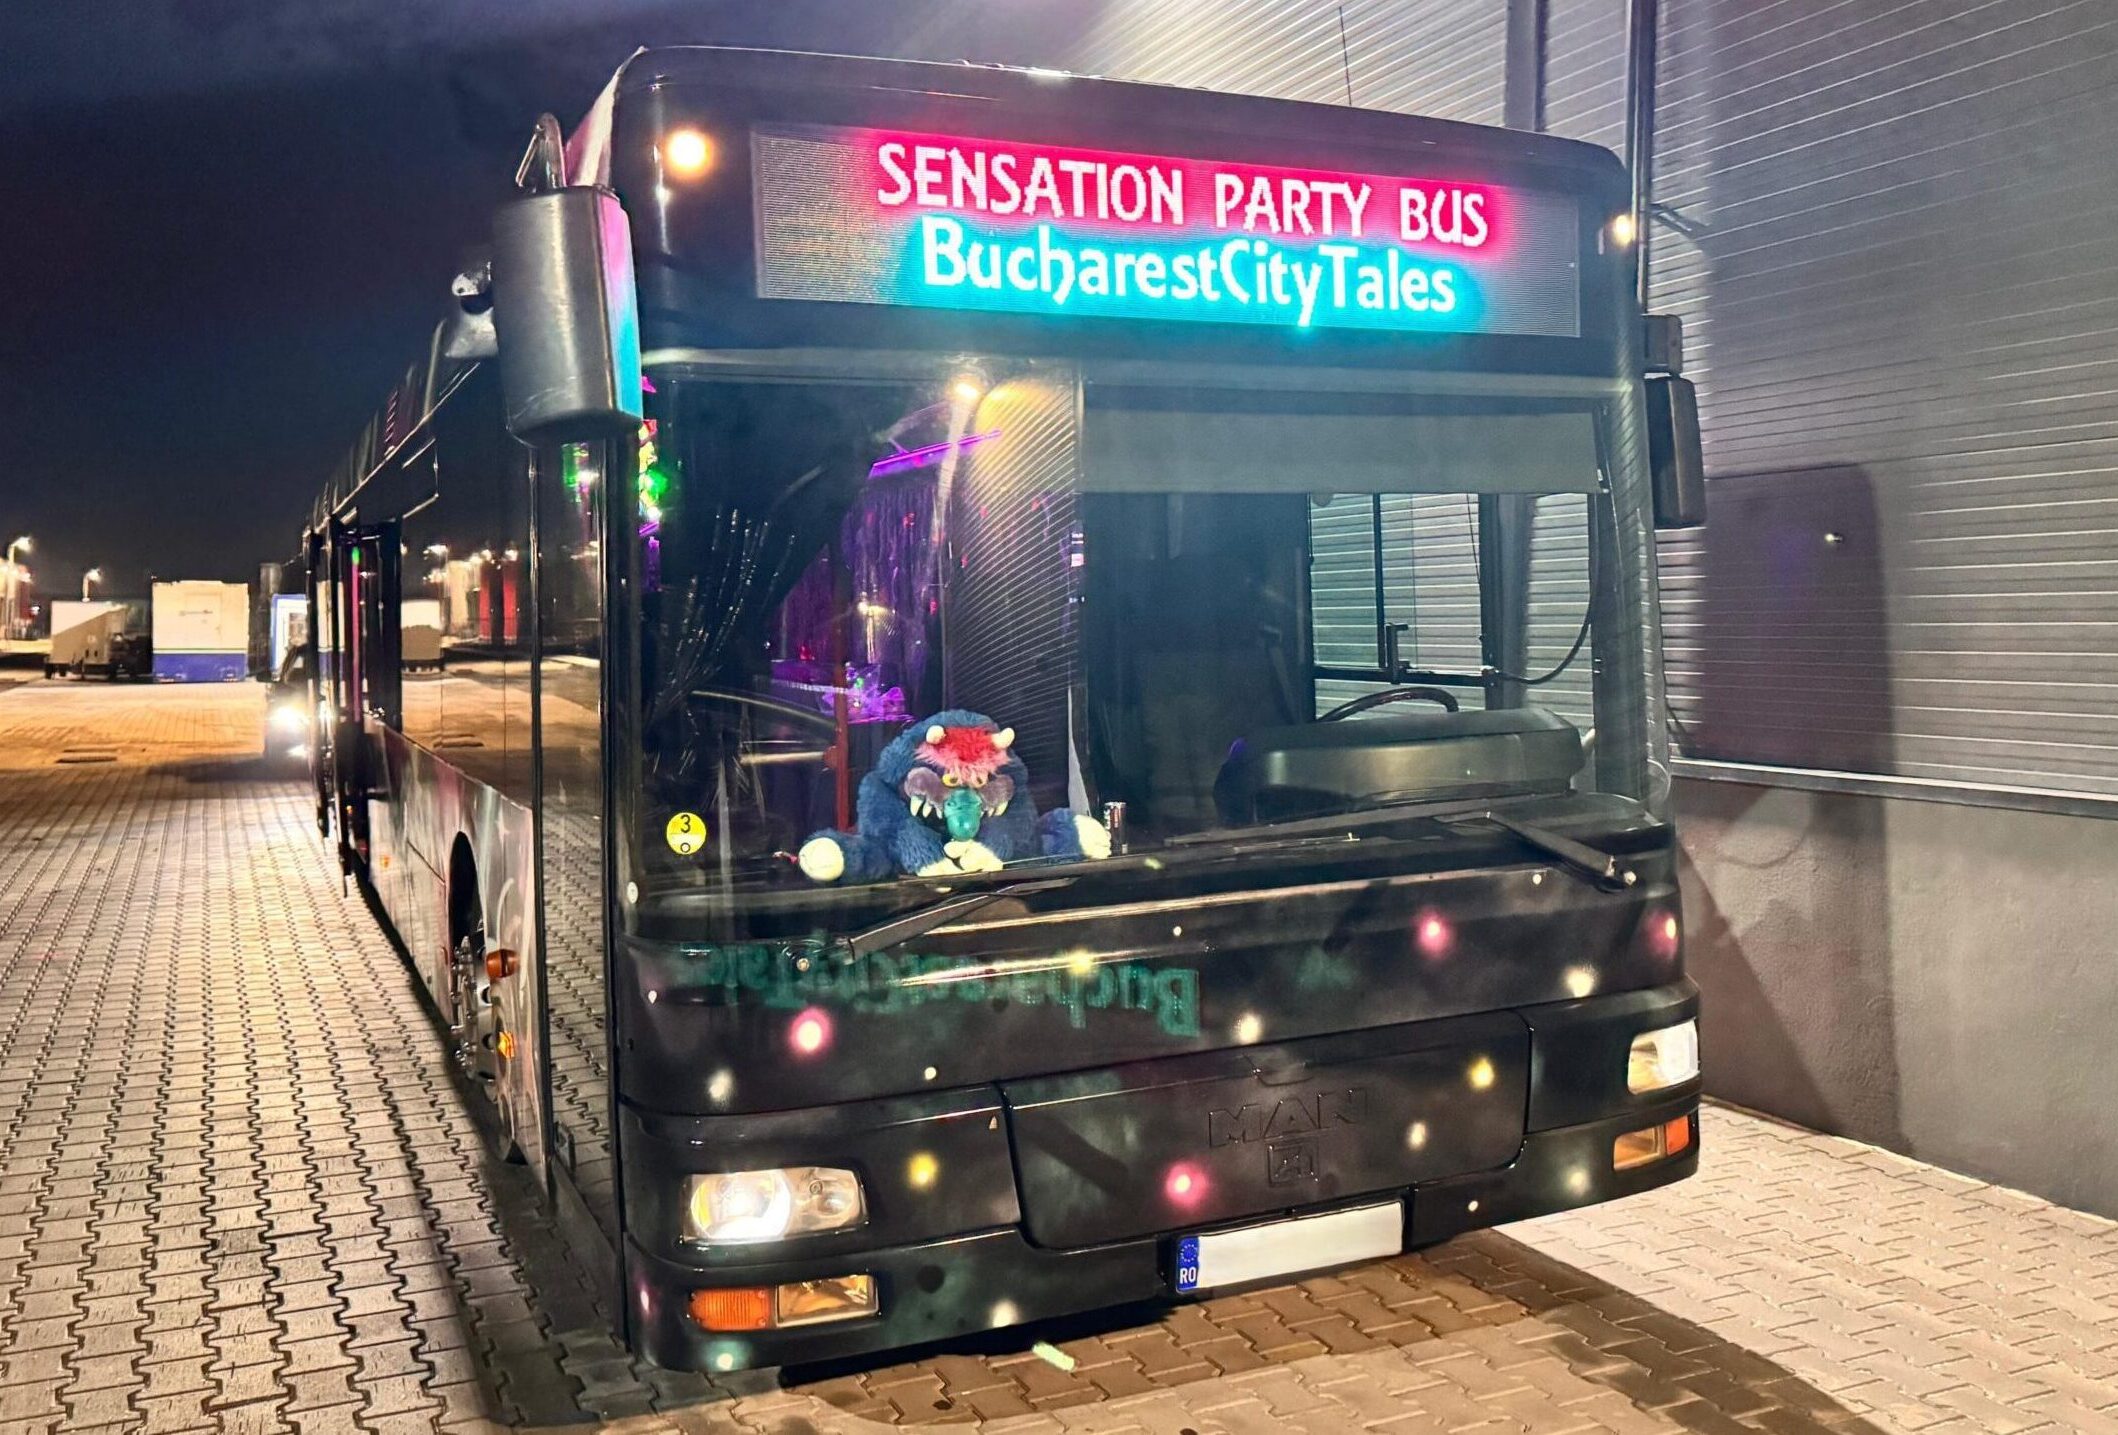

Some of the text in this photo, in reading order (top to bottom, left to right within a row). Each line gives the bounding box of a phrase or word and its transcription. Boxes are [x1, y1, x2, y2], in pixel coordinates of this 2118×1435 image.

[877, 142, 1489, 248] SENSATION PARTY BUS
[921, 214, 1457, 328] BucharestCityTales
[680, 813, 692, 834] 3
[1208, 1086, 1368, 1149] MAN
[1179, 1266, 1197, 1285] RO
